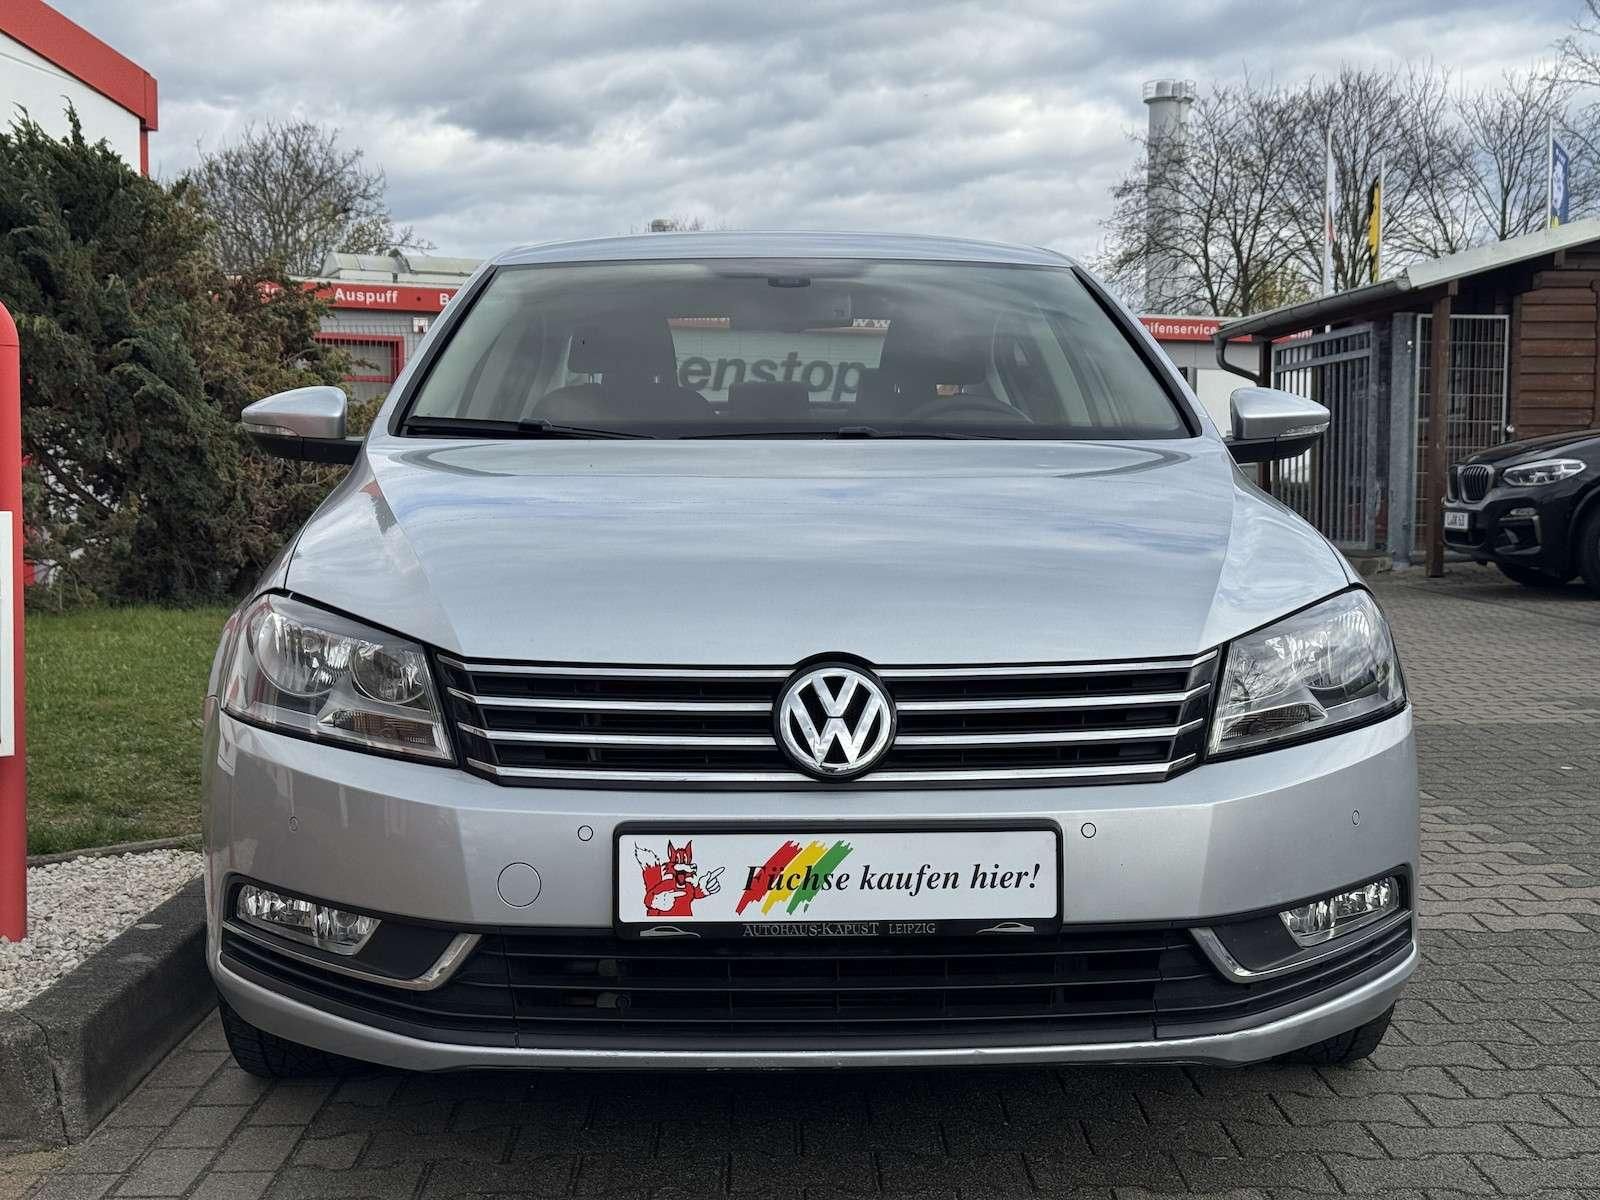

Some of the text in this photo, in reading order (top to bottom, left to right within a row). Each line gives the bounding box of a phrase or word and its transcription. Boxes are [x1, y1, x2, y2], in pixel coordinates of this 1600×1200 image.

[334, 288, 398, 305] Auspuff
[742, 862, 1042, 897] Füchse kaufen hier!
[888, 922, 936, 935] LEIPZIG
